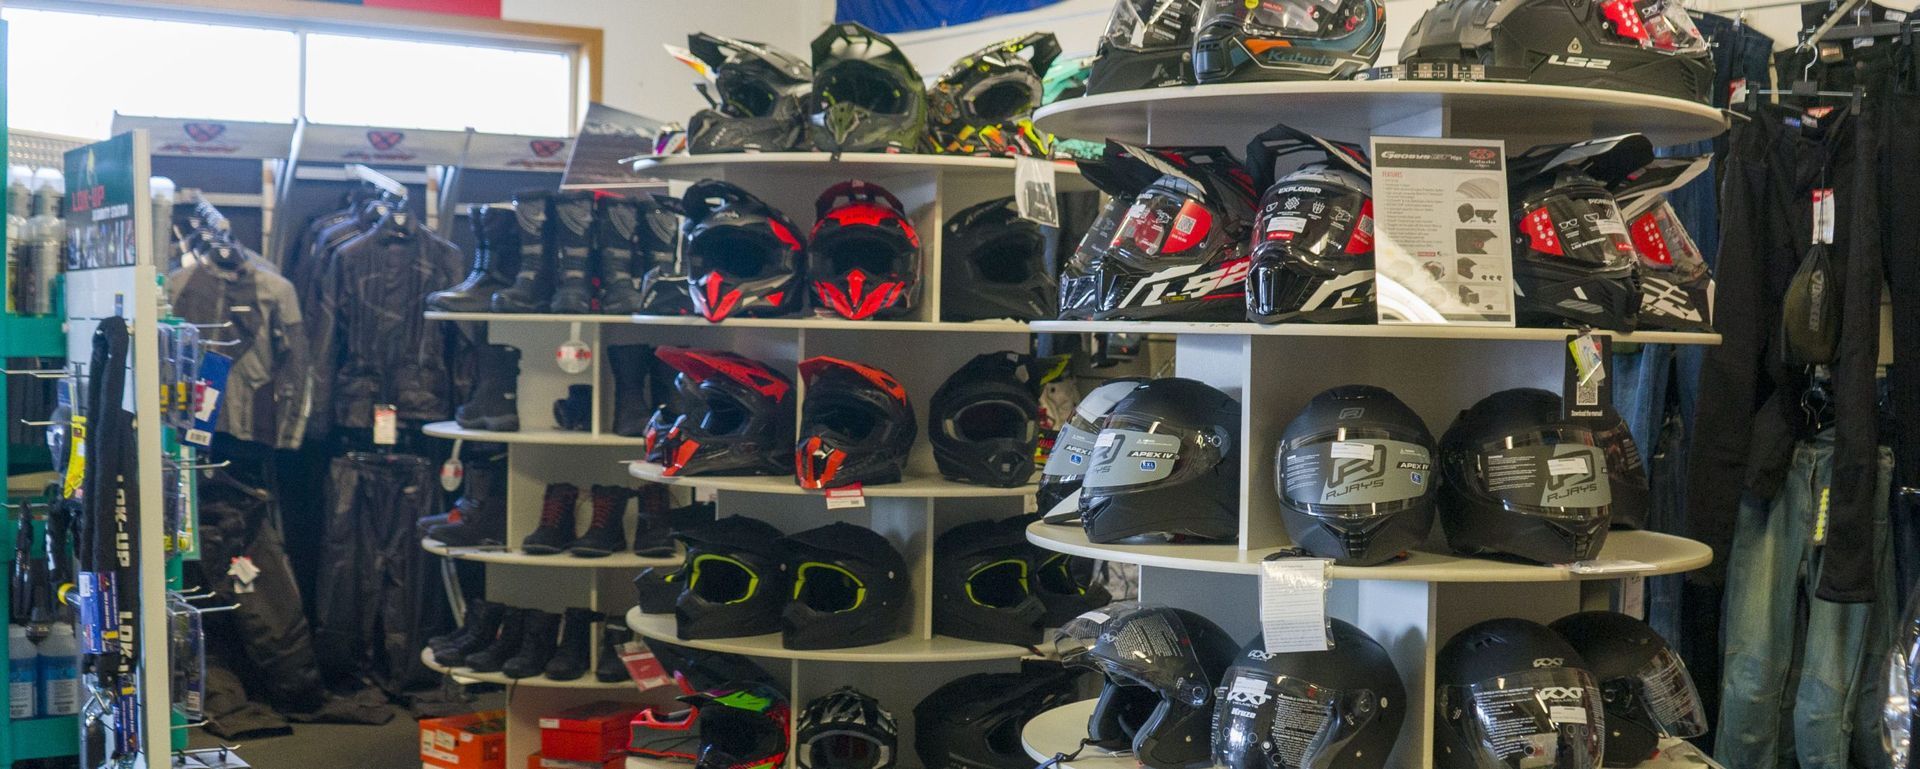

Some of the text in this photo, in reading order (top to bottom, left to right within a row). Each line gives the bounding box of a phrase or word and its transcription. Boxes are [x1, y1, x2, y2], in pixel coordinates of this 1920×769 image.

[1548, 54, 1611, 69] LS2
[1277, 185, 1322, 194] EXPLORER
[1065, 445, 1088, 455] APEX
[1400, 462, 1421, 470] APEX
[1326, 479, 1385, 500] RJAYS
[1547, 483, 1598, 502] RJAYS
